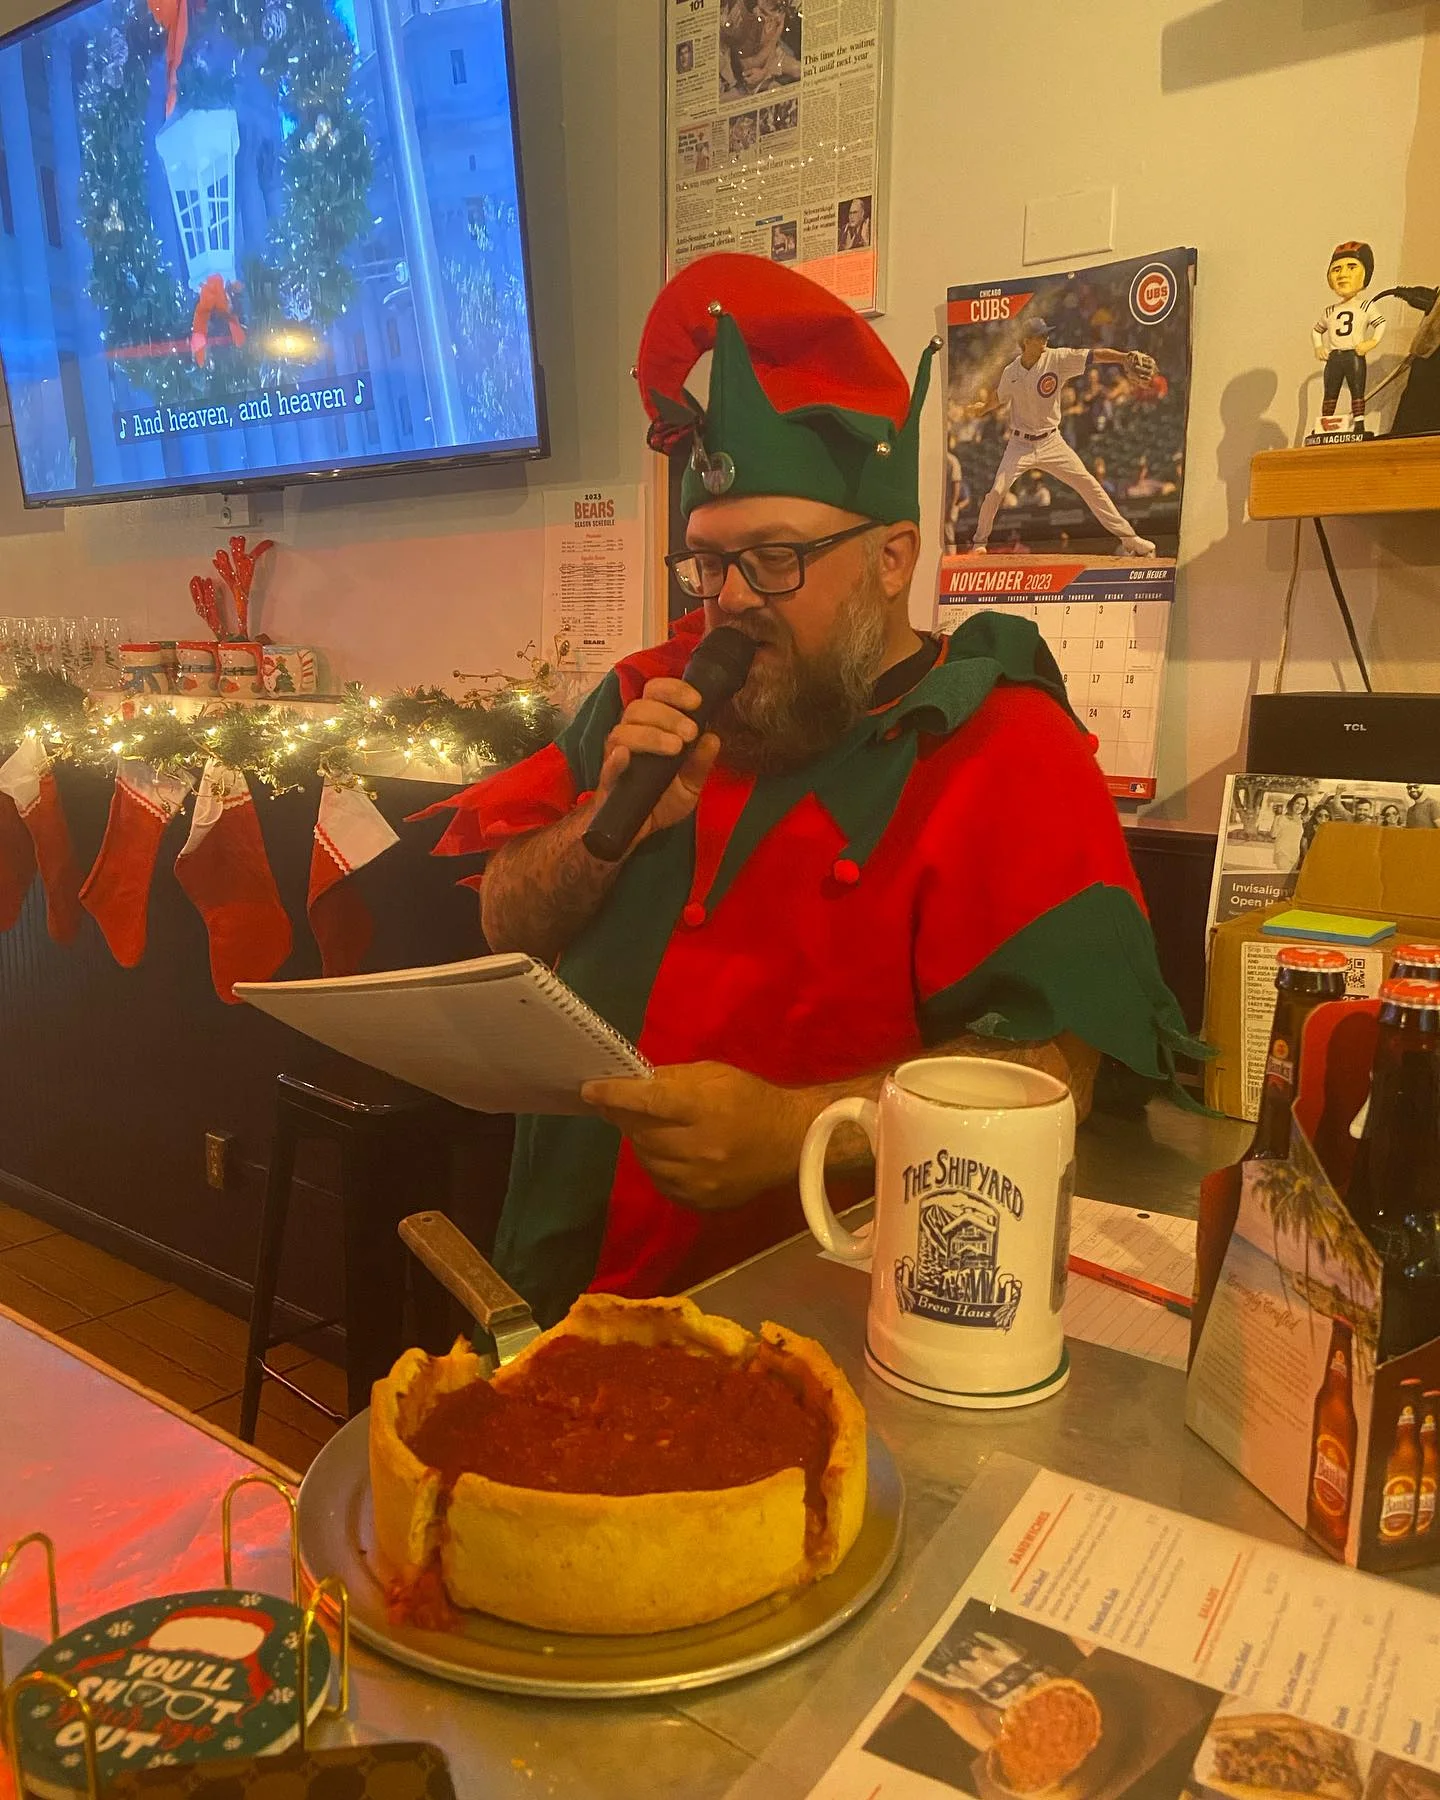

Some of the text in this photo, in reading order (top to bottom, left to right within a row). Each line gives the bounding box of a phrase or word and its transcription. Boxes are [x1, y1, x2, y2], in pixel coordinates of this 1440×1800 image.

[803, 38, 875, 65] This time the waiting
[819, 60, 835, 74] until
[837, 57, 851, 70] next
[853, 52, 869, 66] year
[979, 288, 1002, 298] CHICAGO
[970, 296, 1010, 322] CUBS
[1335, 310, 1354, 337] 3
[134, 386, 347, 437] And heaven, and heaven
[1322, 433, 1364, 444] NAGURSKI
[584, 493, 602, 501] 2023
[574, 499, 615, 521] BEARS
[592, 519, 615, 527] SCHEDULE
[949, 571, 1053, 592] NOVEMBER 2023
[1034, 604, 1137, 615] 1 2 3 4
[1062, 639, 1137, 649] 9 10 11
[1091, 674, 1100, 684] 17
[1125, 674, 1134, 684] 18
[1088, 709, 1131, 719] 24 25
[1343, 723, 1367, 732] TCL
[1230, 895, 1262, 908] Open
[902, 1149, 1024, 1221] THE SHIPYARD
[918, 1295, 992, 1319] Brew Haus
[124, 1654, 236, 1692] YOU'LL
[55, 1721, 161, 1760] OUT
